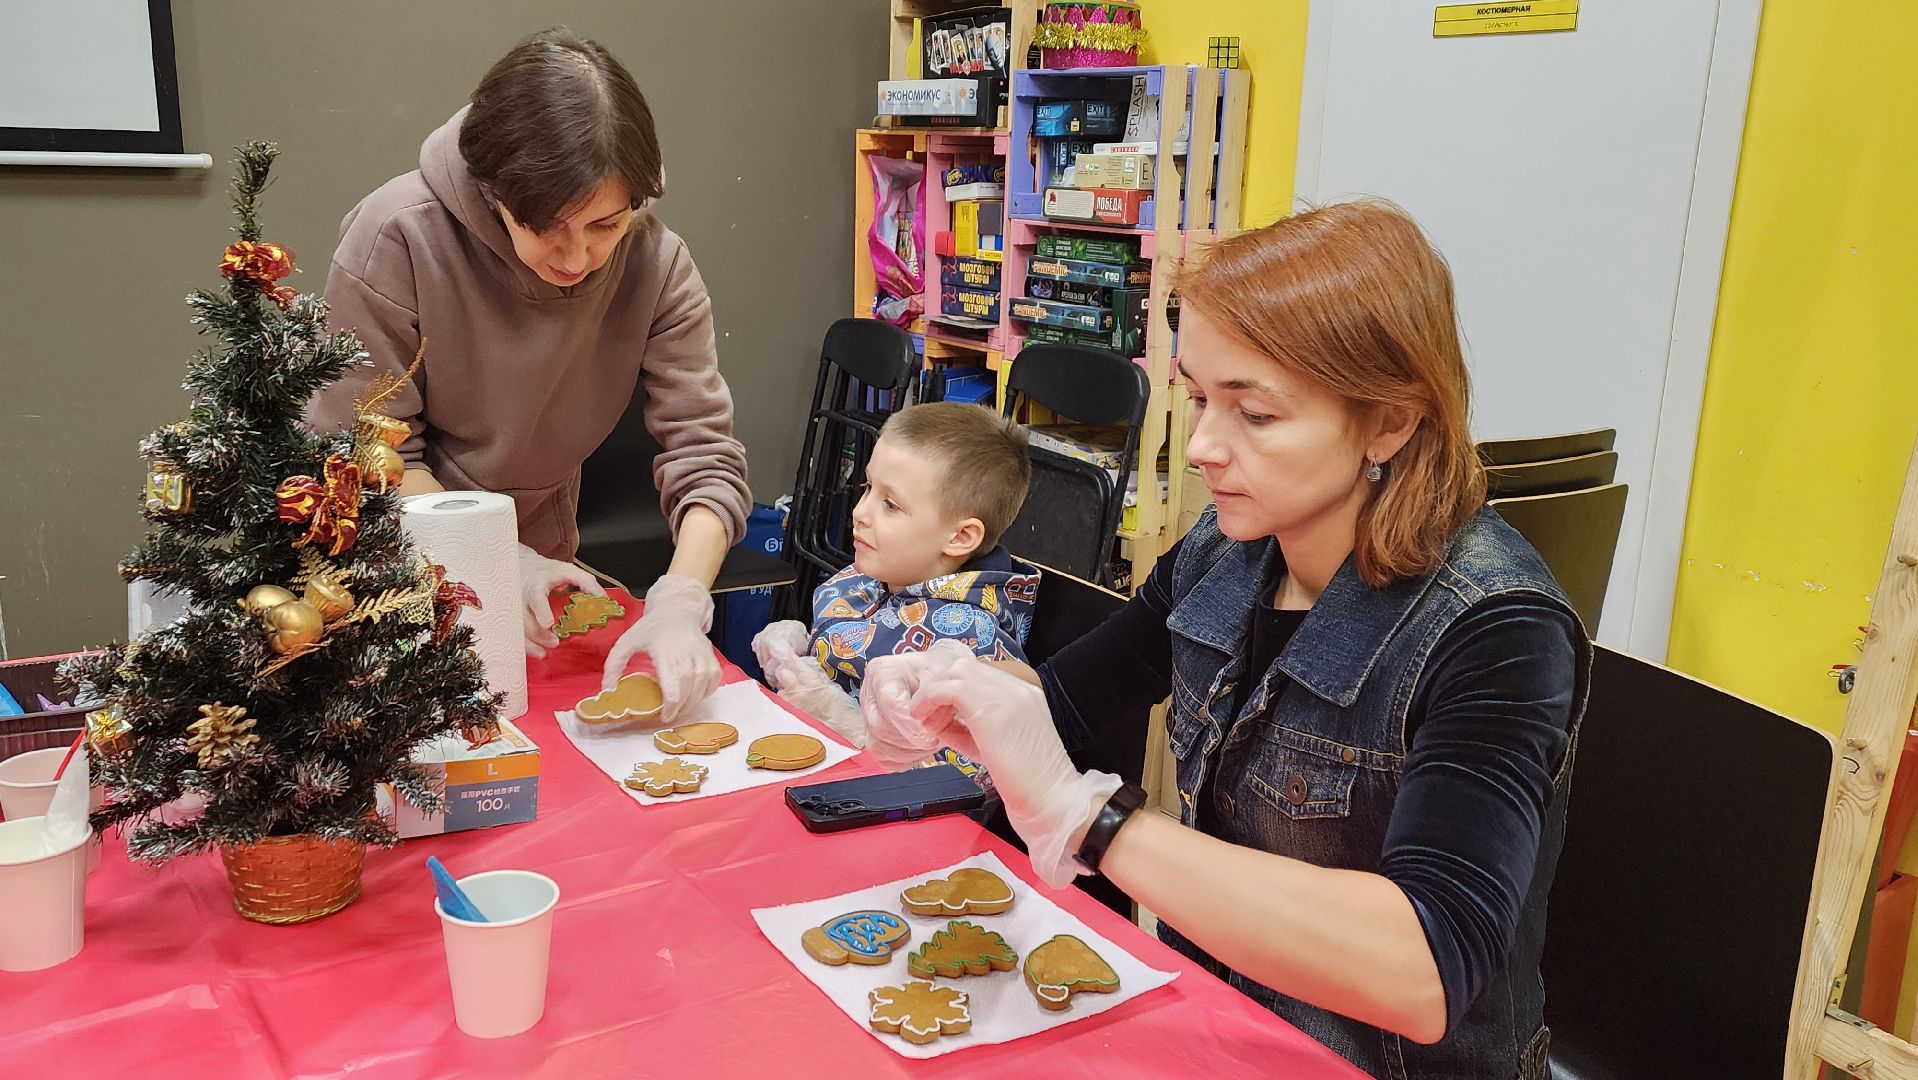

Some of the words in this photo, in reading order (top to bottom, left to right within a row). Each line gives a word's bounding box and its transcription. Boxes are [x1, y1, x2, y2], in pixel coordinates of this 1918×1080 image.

[1477, 5, 1531, 15] КОСТЮМЕРНАЯ
[888, 89, 940, 101] ЭКОНОМИКУС
[1037, 107, 1051, 116] EXIT
[1088, 105, 1104, 115] EXIT
[1128, 77, 1144, 136] SPLASH
[1097, 197, 1122, 212] ПОБЕДА
[959, 262, 994, 275] МОЗГОВОЙ
[1033, 261, 1068, 277] PANDEMIC
[964, 273, 989, 285] ШТУРМ
[959, 292, 994, 307] МОЗГОВОЙ
[964, 302, 989, 315] ШТУРМ
[1014, 304, 1047, 319] PANDEMIC
[487, 763, 498, 776] L
[476, 798, 503, 812] 100
